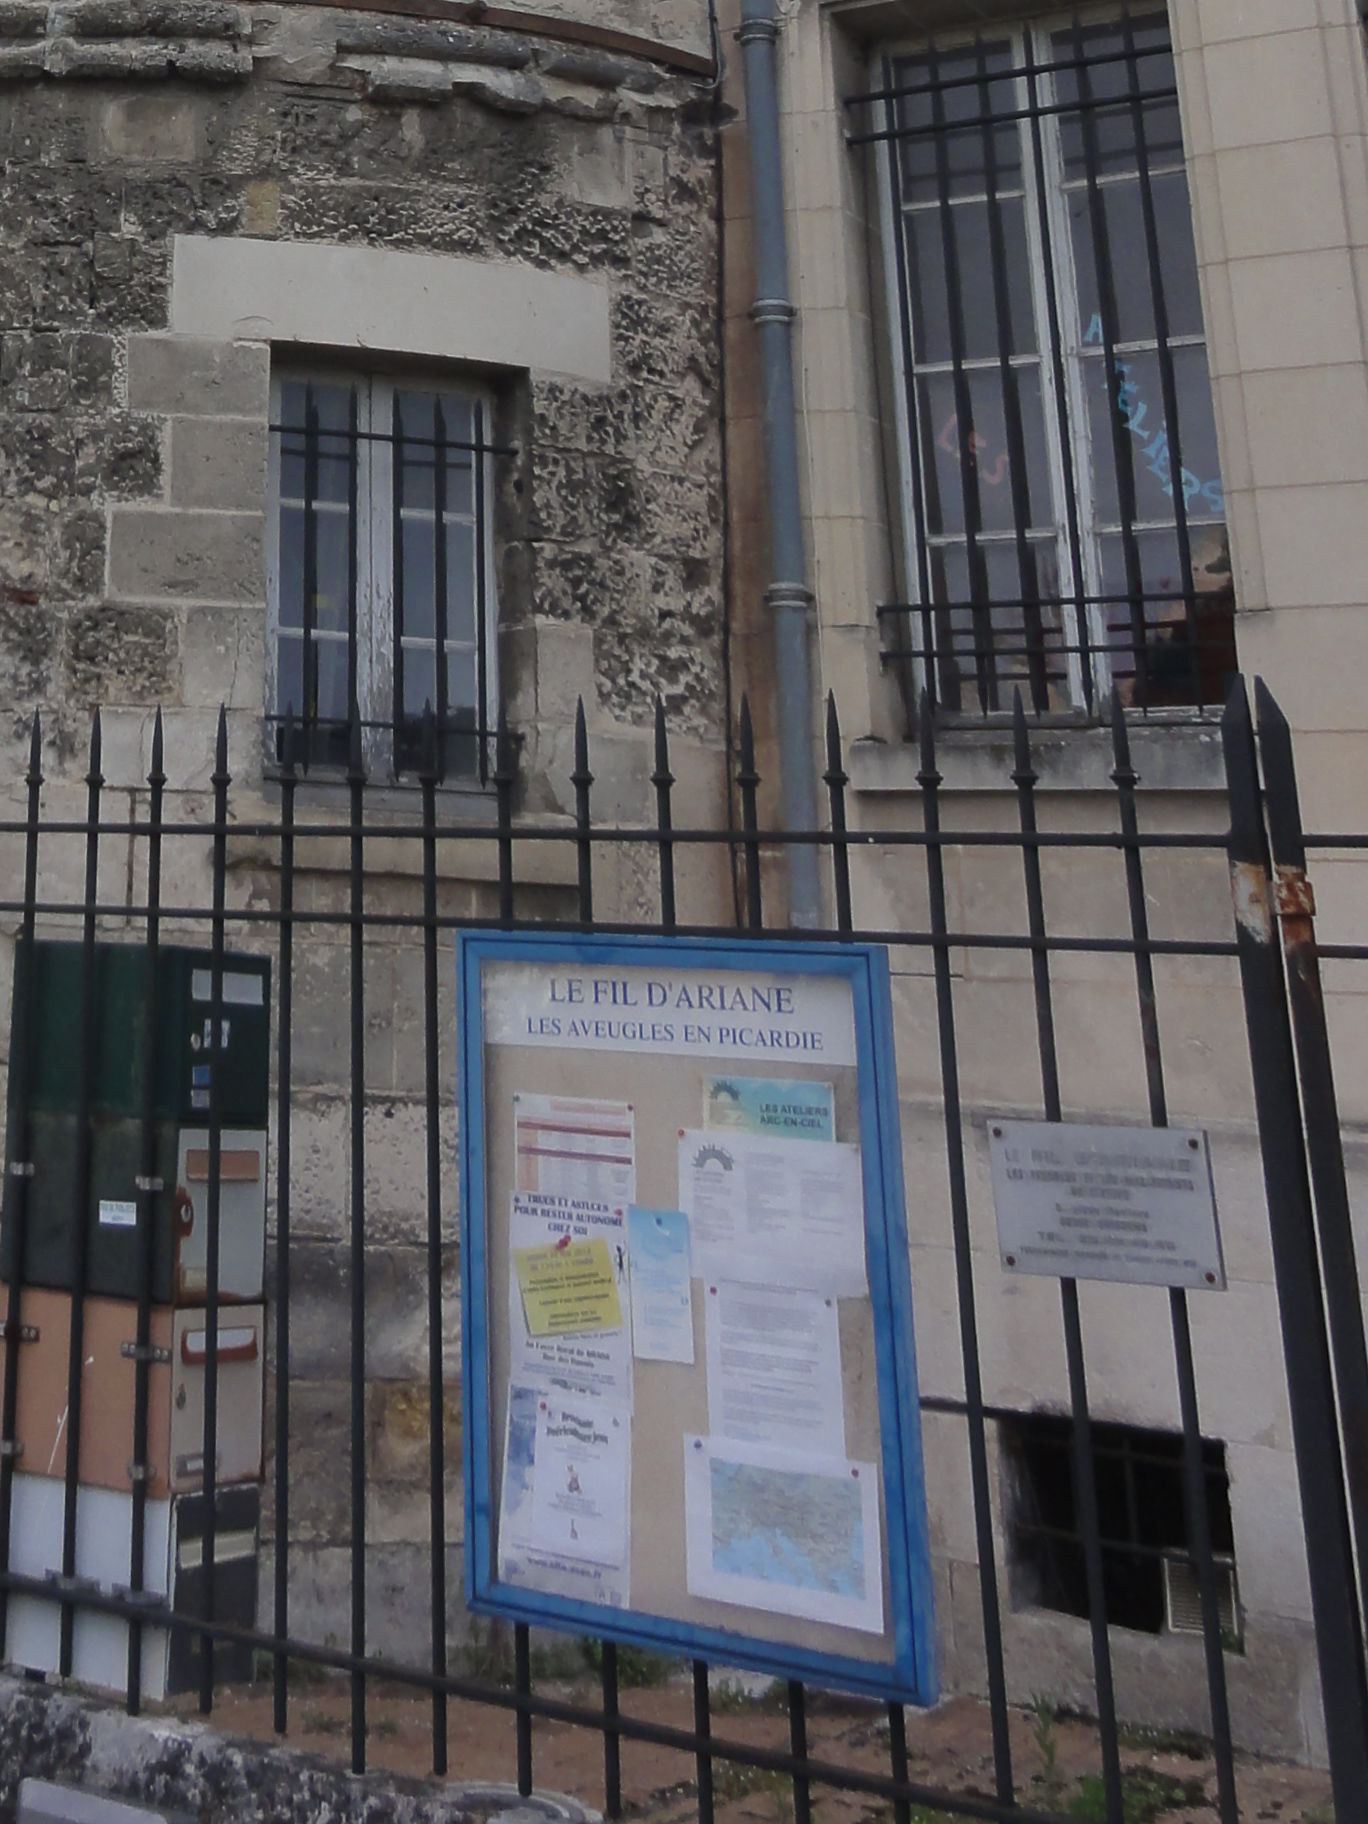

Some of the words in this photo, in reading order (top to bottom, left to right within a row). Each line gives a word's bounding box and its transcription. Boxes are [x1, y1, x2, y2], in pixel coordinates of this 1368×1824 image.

[549, 978, 584, 1004] LE
[592, 980, 637, 1007] FIL
[646, 981, 795, 1014] D'ARIANE
[526, 1017, 562, 1036] LES
[567, 1019, 674, 1043] AVEUGLES
[684, 1025, 712, 1044] EN
[718, 1026, 824, 1051] PICARDIE
[759, 1103, 778, 1114] LES
[780, 1104, 829, 1117] ATELIERS
[528, 1194, 556, 1206] TRUCS
[558, 1197, 569, 1207] ET
[571, 1200, 609, 1212] ASTUCES
[514, 1205, 538, 1216] POUR
[540, 1209, 573, 1222] RESTER
[576, 1213, 623, 1227] AUTONOME
[548, 1223, 570, 1234] CHEZ
